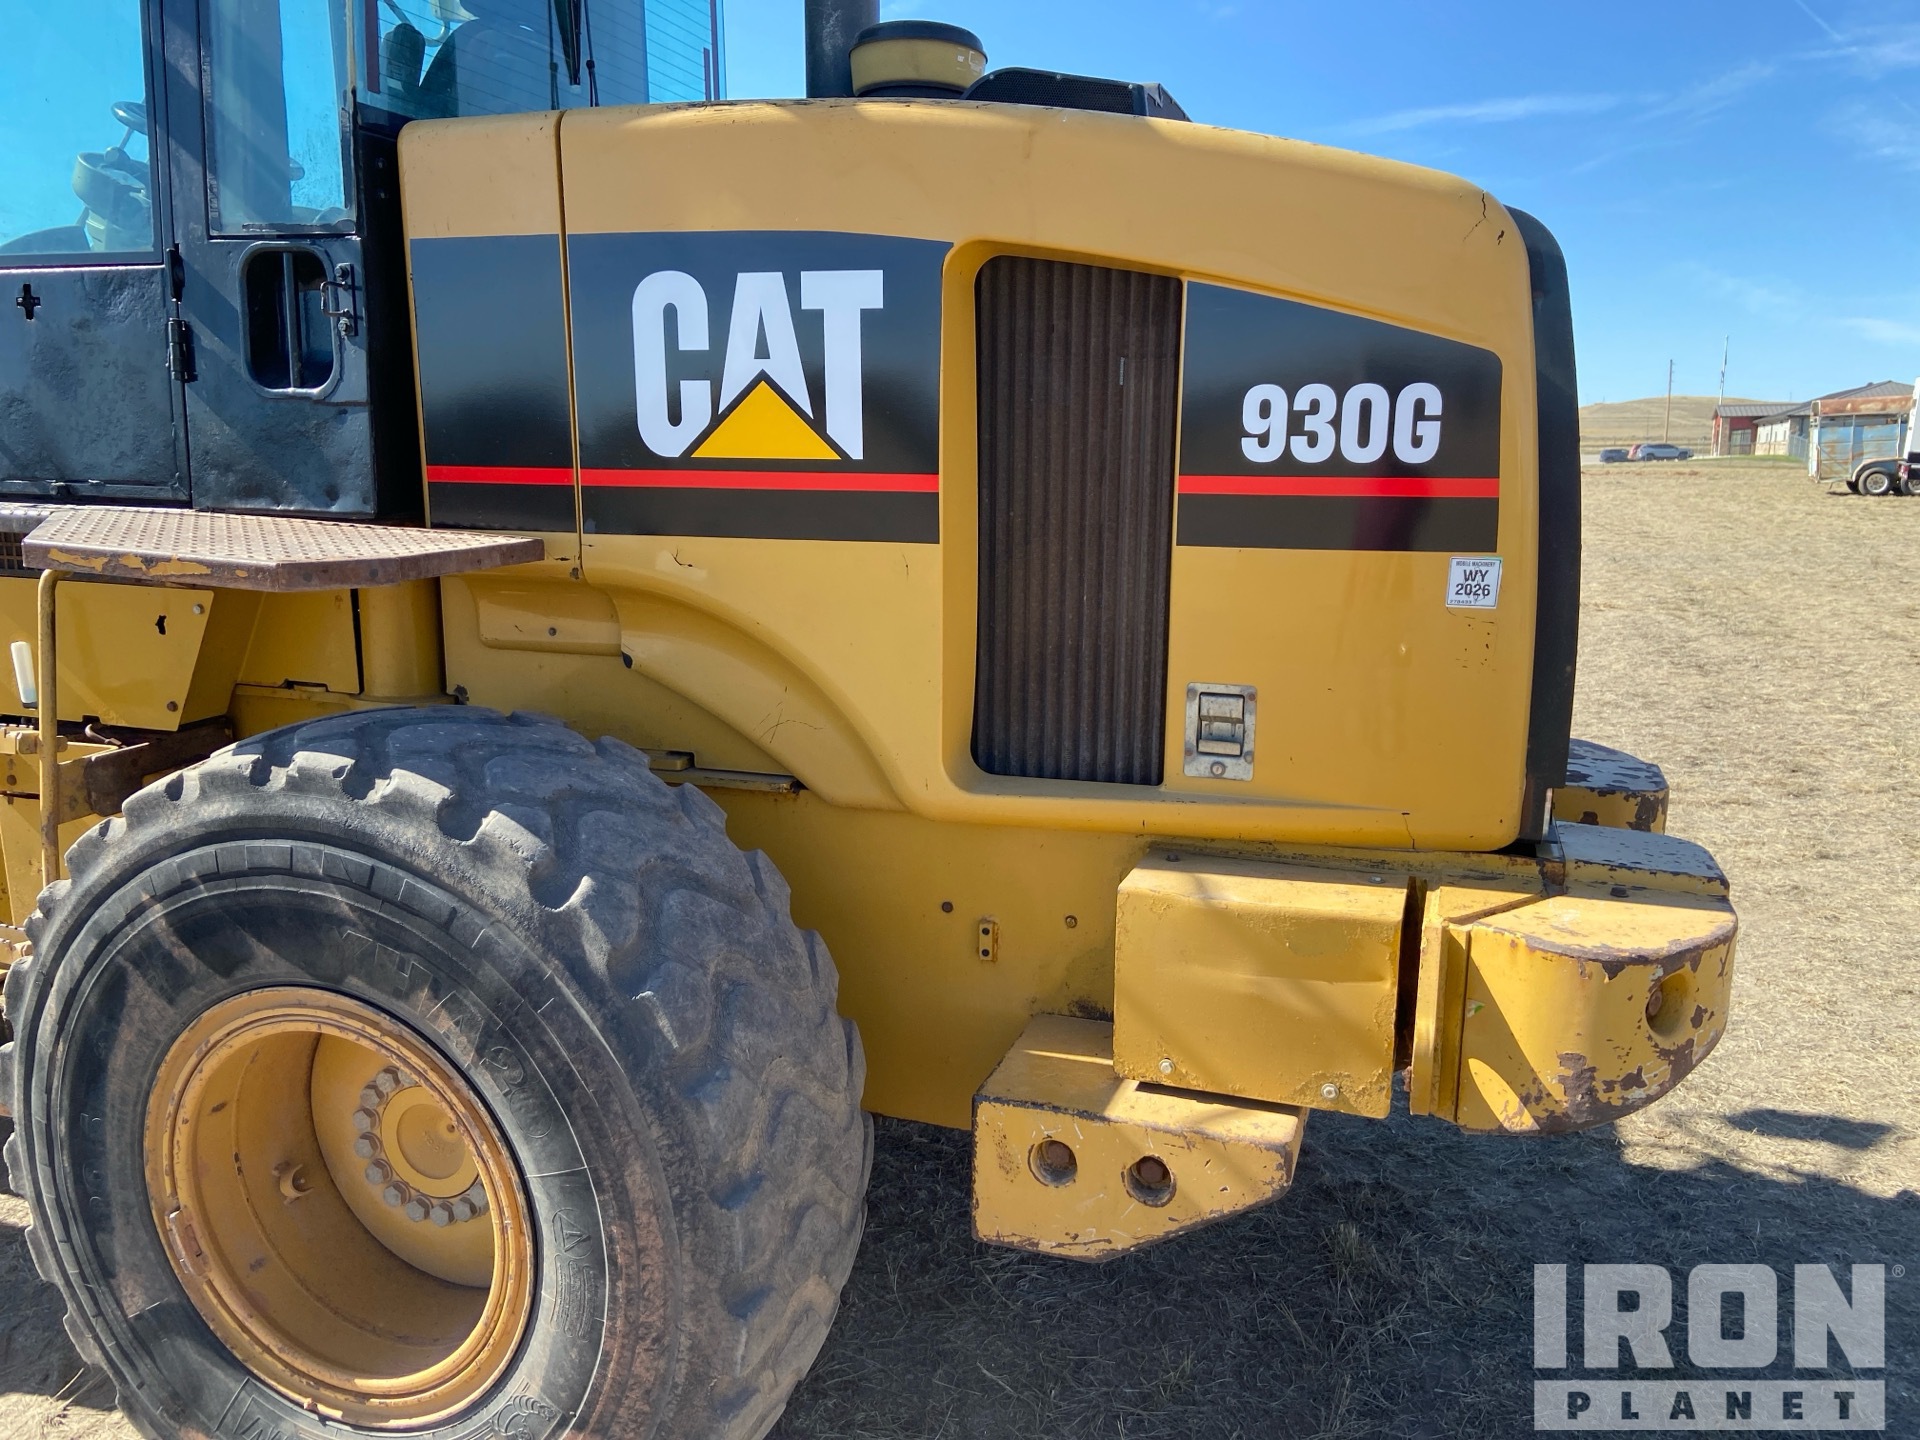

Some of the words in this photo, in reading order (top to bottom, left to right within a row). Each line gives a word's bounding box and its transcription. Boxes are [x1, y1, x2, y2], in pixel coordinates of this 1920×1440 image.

[632, 269, 883, 460] CAT
[1241, 382, 1443, 464] 930G
[1455, 583, 1491, 597] 2026
[1463, 569, 1489, 583] WY
